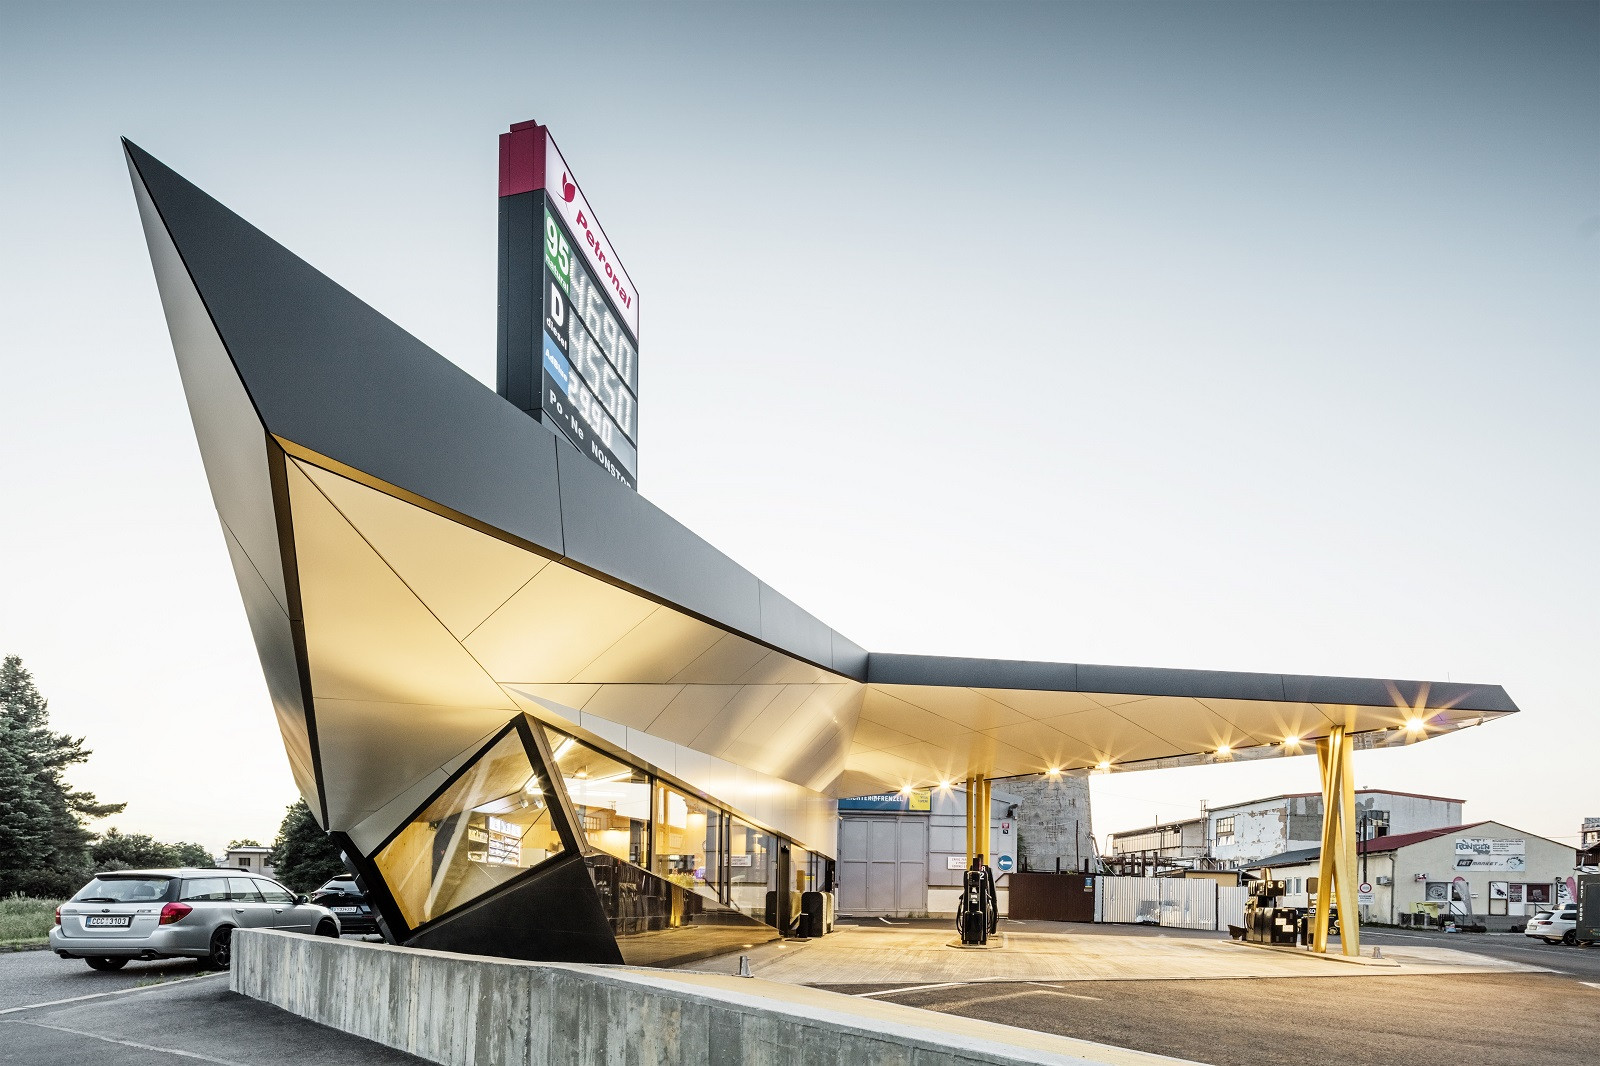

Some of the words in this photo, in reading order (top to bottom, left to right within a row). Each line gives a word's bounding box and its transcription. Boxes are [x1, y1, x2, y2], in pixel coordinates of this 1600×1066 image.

[546, 216, 569, 276] 95
[576, 209, 631, 309] Petronal
[545, 253, 569, 294] natural
[551, 282, 564, 326] D
[546, 317, 567, 350] diesel
[549, 388, 563, 415] Po
[571, 415, 584, 440] Ne
[980, 872, 985, 880] 2
